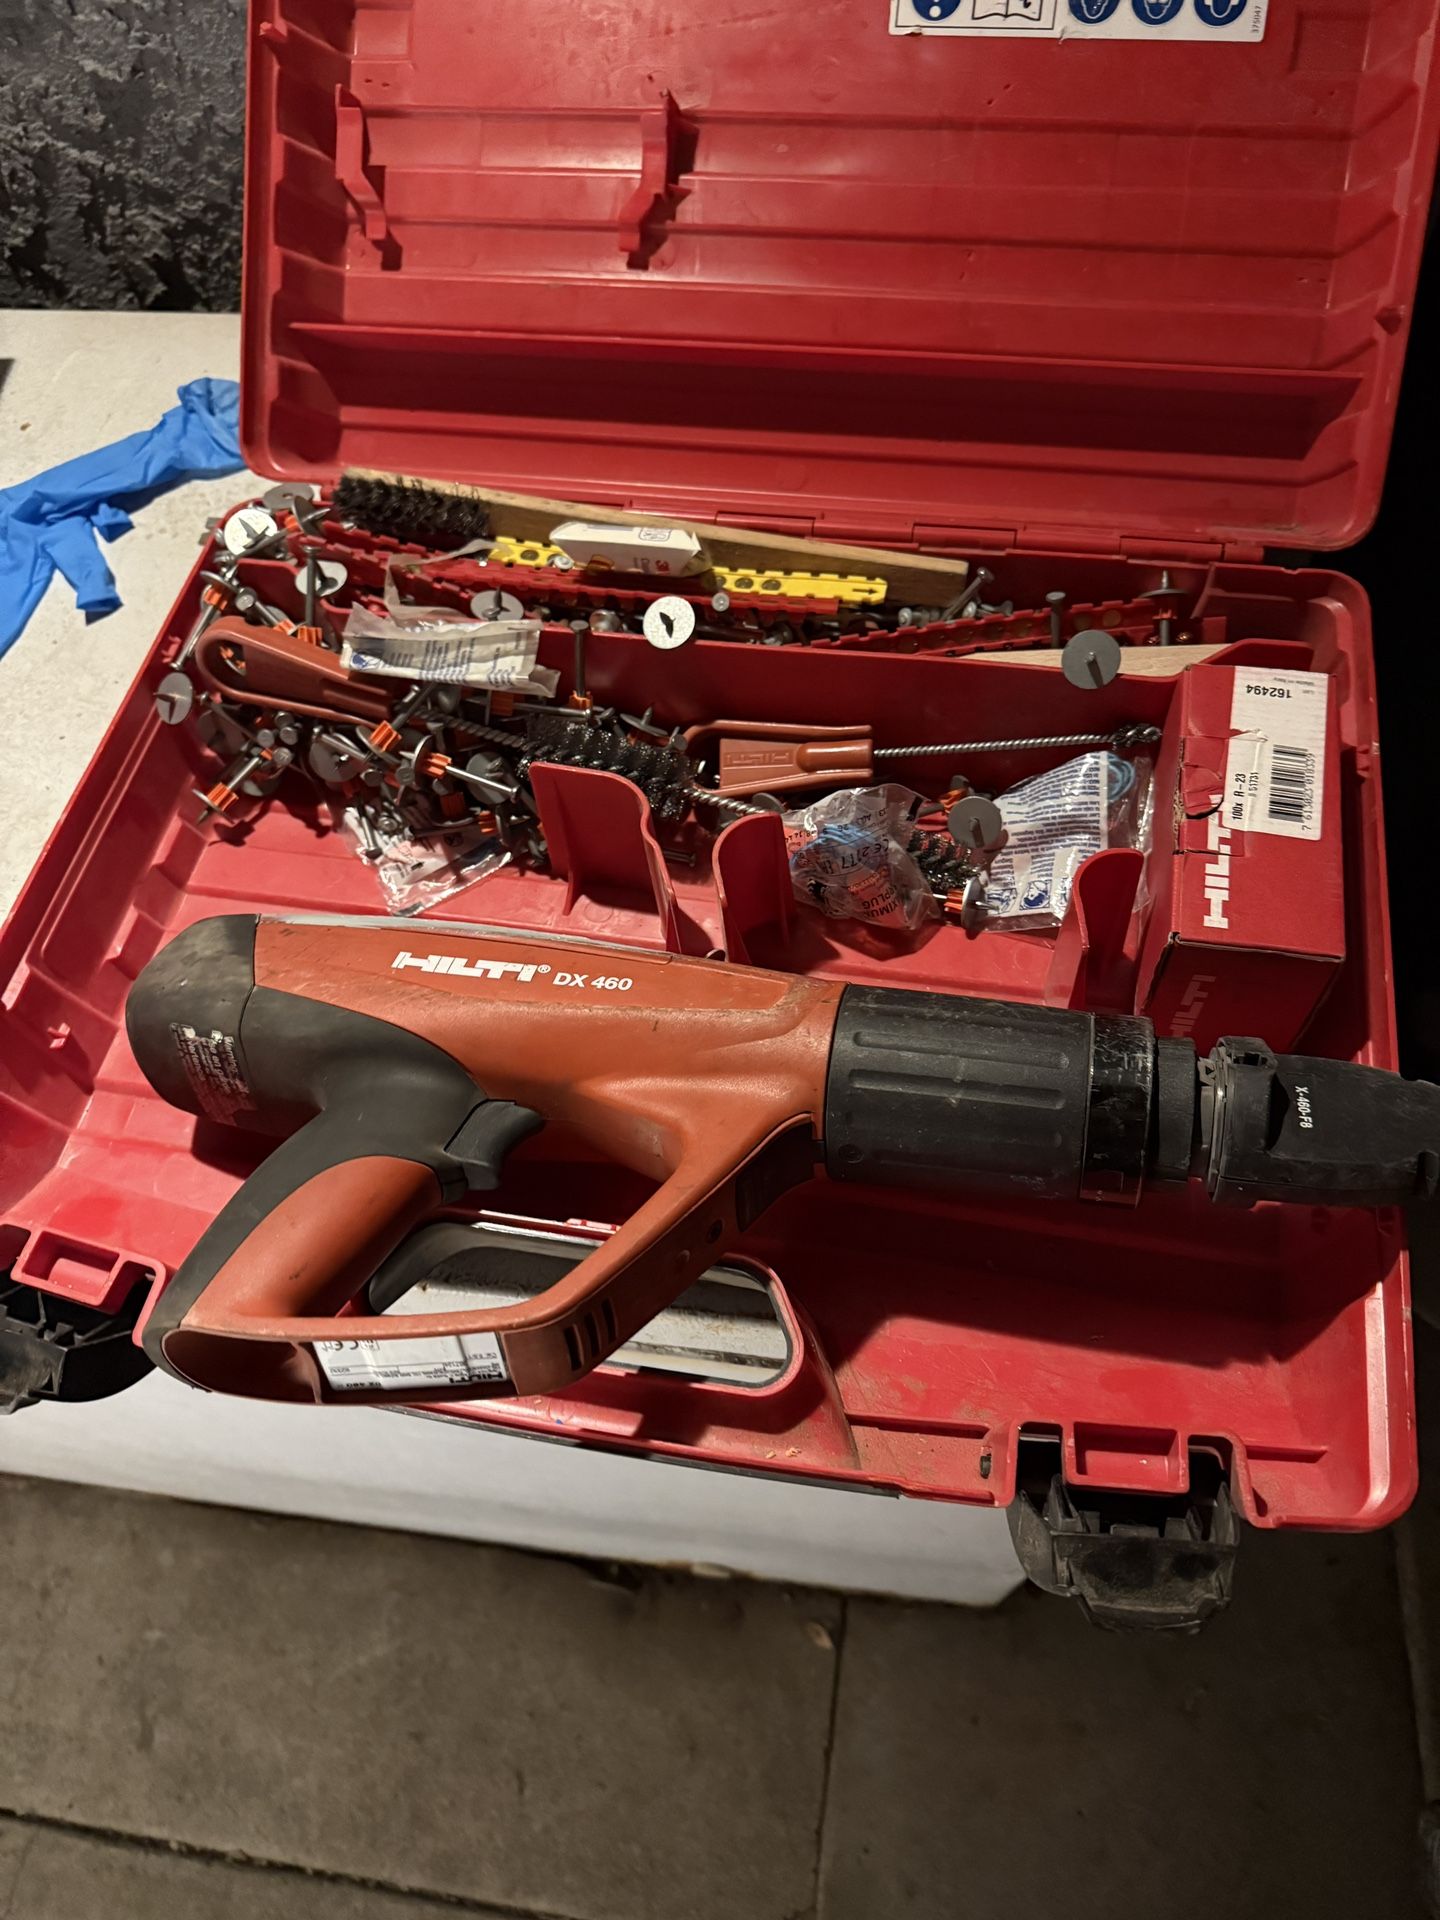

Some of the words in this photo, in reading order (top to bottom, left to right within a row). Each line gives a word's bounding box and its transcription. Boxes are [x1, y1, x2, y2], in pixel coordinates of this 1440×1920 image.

[1246, 684, 1292, 699] 162494
[1232, 802, 1244, 821] 100x
[552, 972, 590, 987] DX
[591, 975, 634, 991] 460
